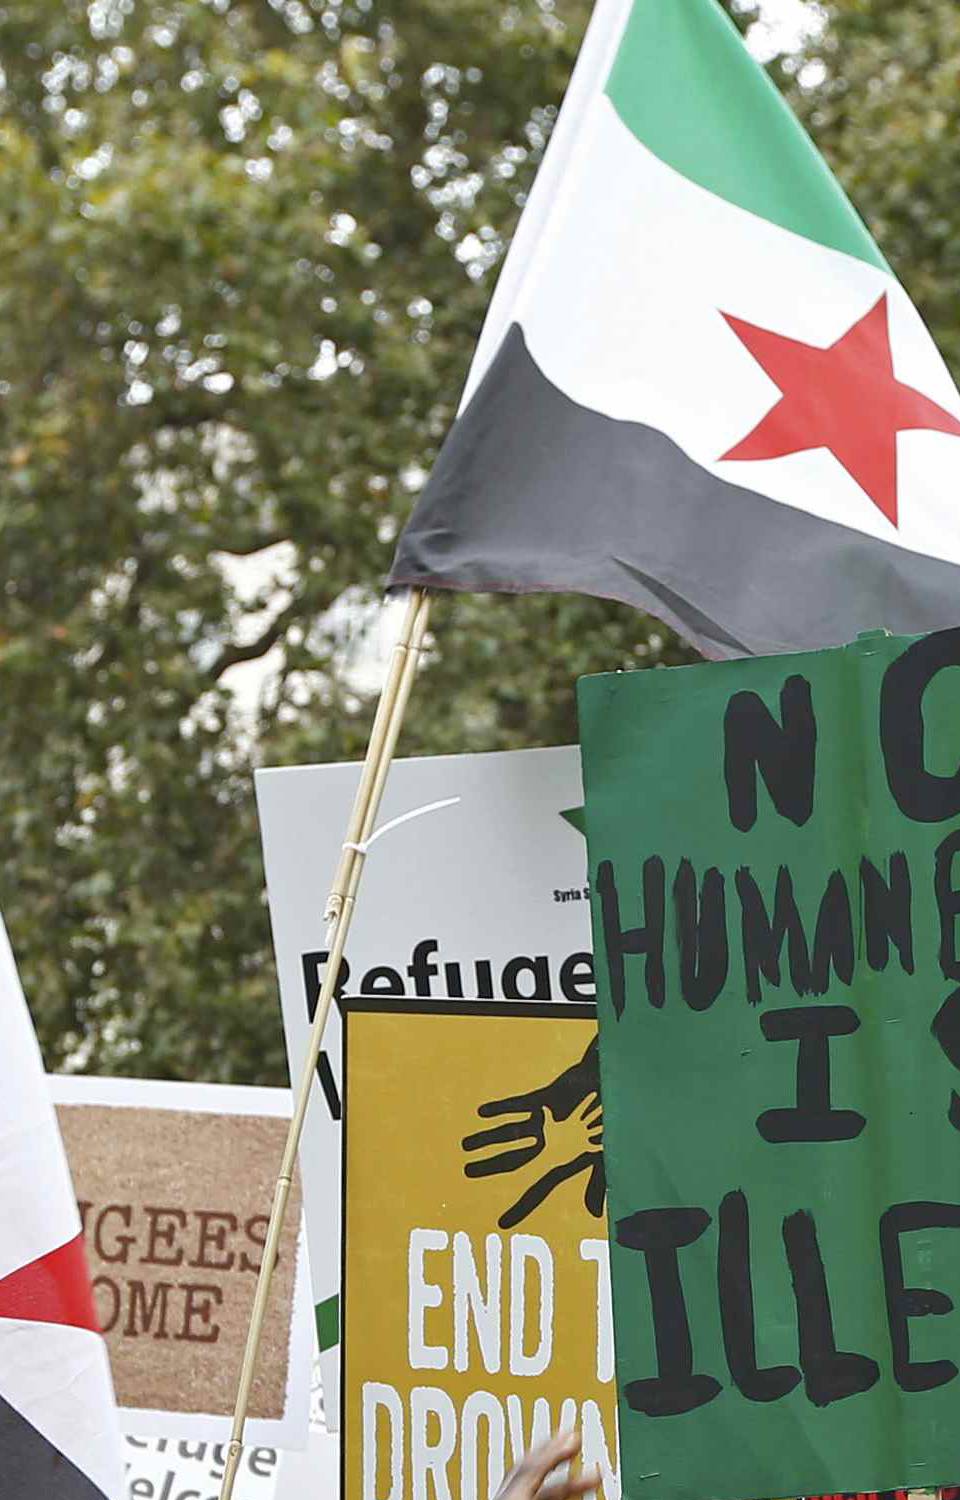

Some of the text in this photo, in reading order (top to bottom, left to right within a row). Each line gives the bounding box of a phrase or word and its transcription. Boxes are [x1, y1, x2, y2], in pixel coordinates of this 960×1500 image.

[597, 851, 914, 1022] HUMAN
[79, 1200, 279, 1276] GEES
[408, 1227, 555, 1377] END
